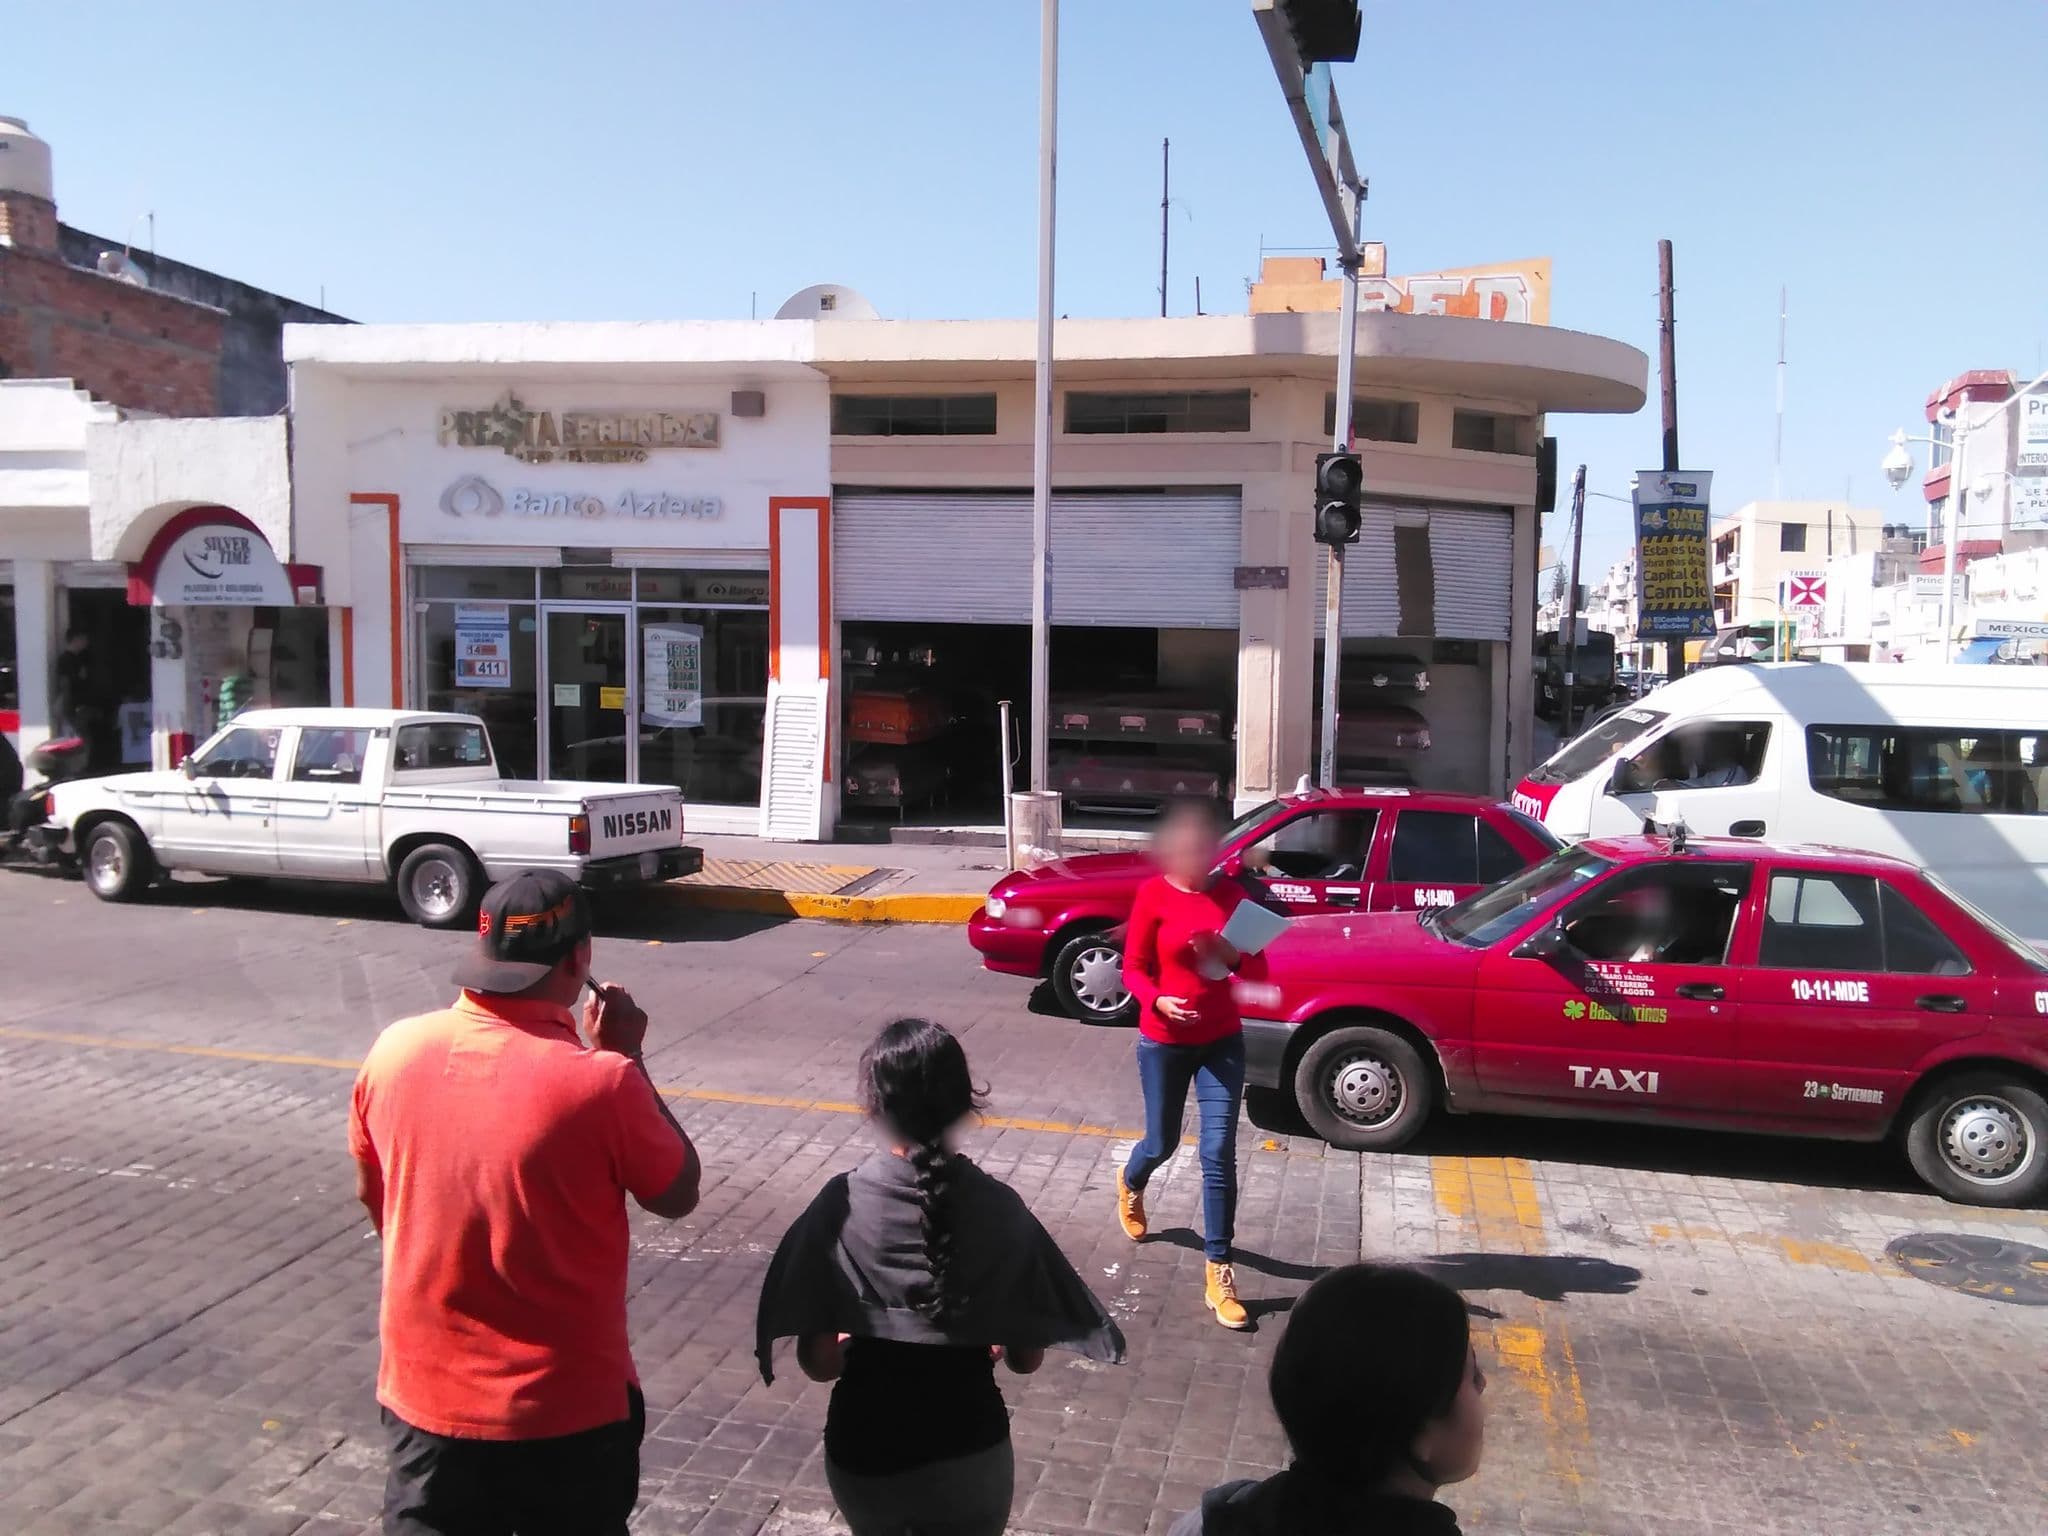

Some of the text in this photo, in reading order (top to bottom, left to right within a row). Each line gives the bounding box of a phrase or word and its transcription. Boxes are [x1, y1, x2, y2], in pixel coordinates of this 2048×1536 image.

[512, 487, 723, 518] Banco Azteca
[204, 536, 250, 551] SILVER
[1642, 545, 1668, 556] Esta
[1671, 545, 1685, 555] es
[220, 551, 250, 565] TIME
[1643, 567, 1687, 583] Capital
[1643, 582, 1707, 600] Cambio
[603, 808, 672, 839] NISSAN
[1615, 980, 1648, 989] FEBRERO
[1622, 989, 1655, 997] AGOSTO
[1791, 979, 1870, 1003] 10-11-MDE
[1568, 1065, 1660, 1094] TAXI
[1803, 1080, 1818, 1098] 23
